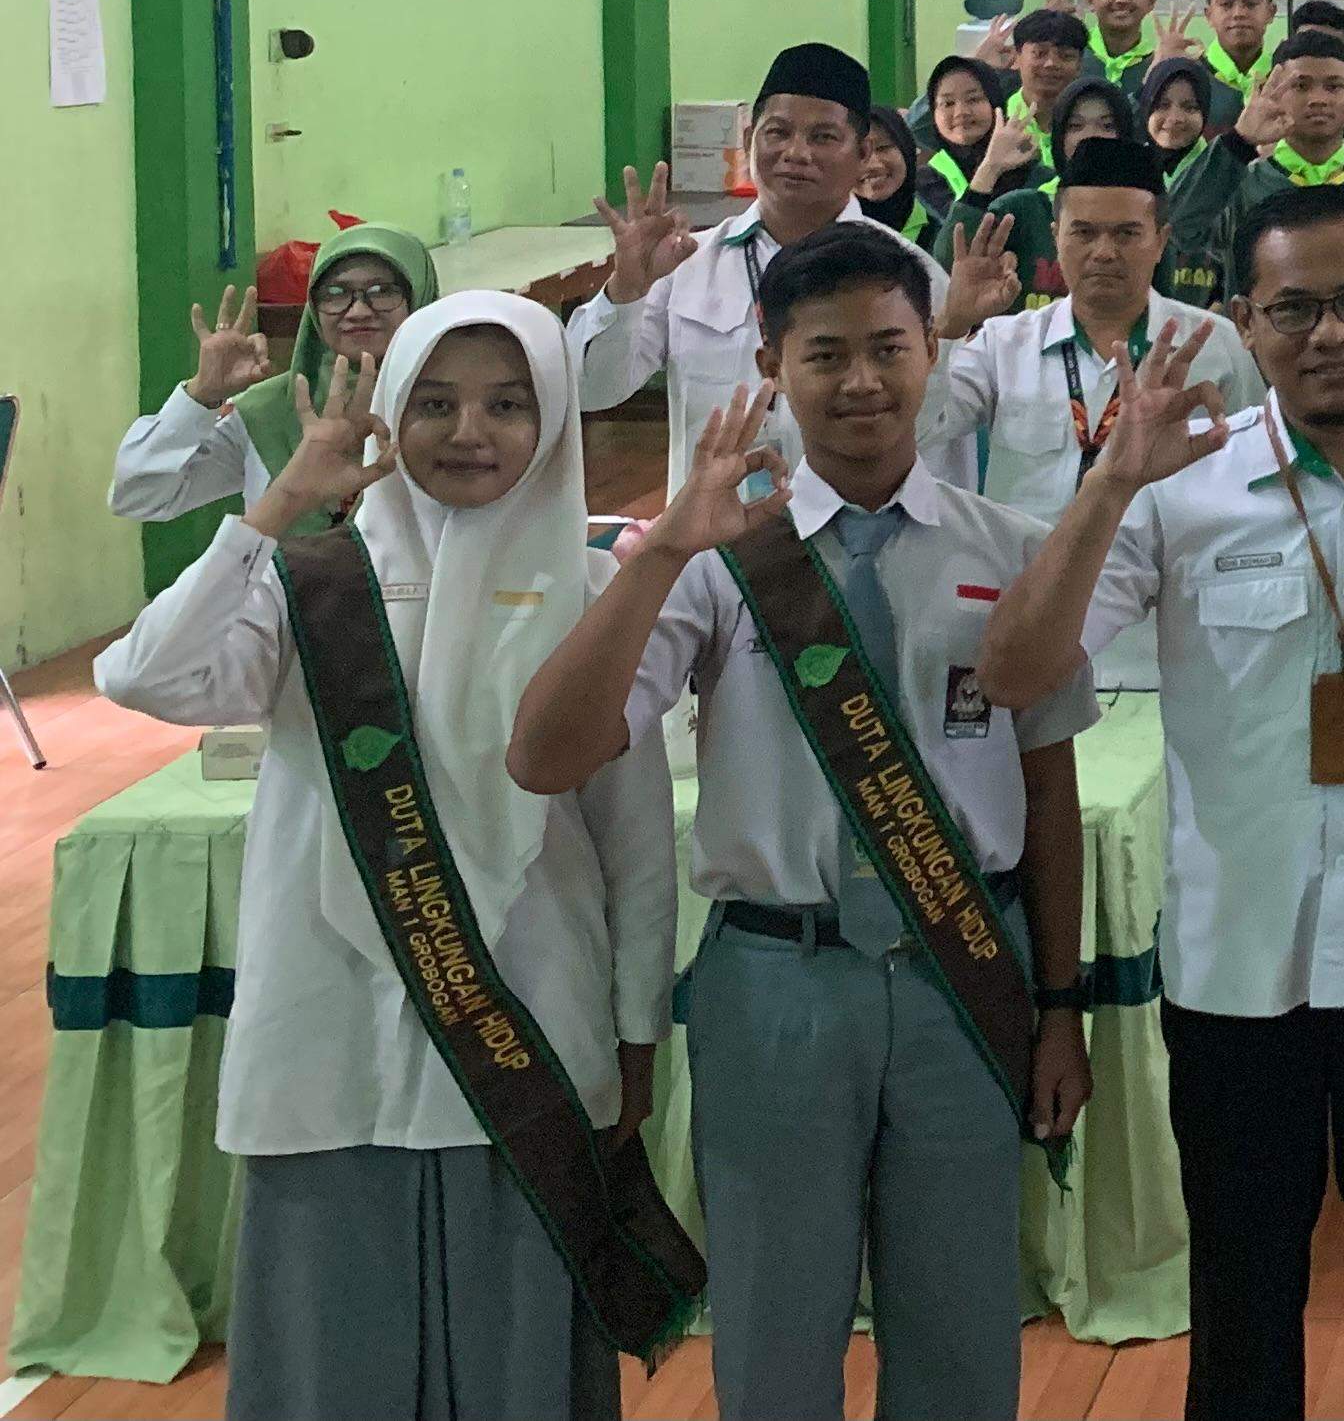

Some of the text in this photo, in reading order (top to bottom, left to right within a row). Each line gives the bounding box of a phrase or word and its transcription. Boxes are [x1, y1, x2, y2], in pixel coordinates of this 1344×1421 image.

[384, 783, 531, 1071] DUTA LINGKUNGAN HIDUP
[840, 691, 999, 962] DUTA LINGKUNGAN HIDUP
[857, 776, 947, 925] MAN 1 GROBOGAN
[386, 869, 464, 1027] MAN 1 GROBOGAN
